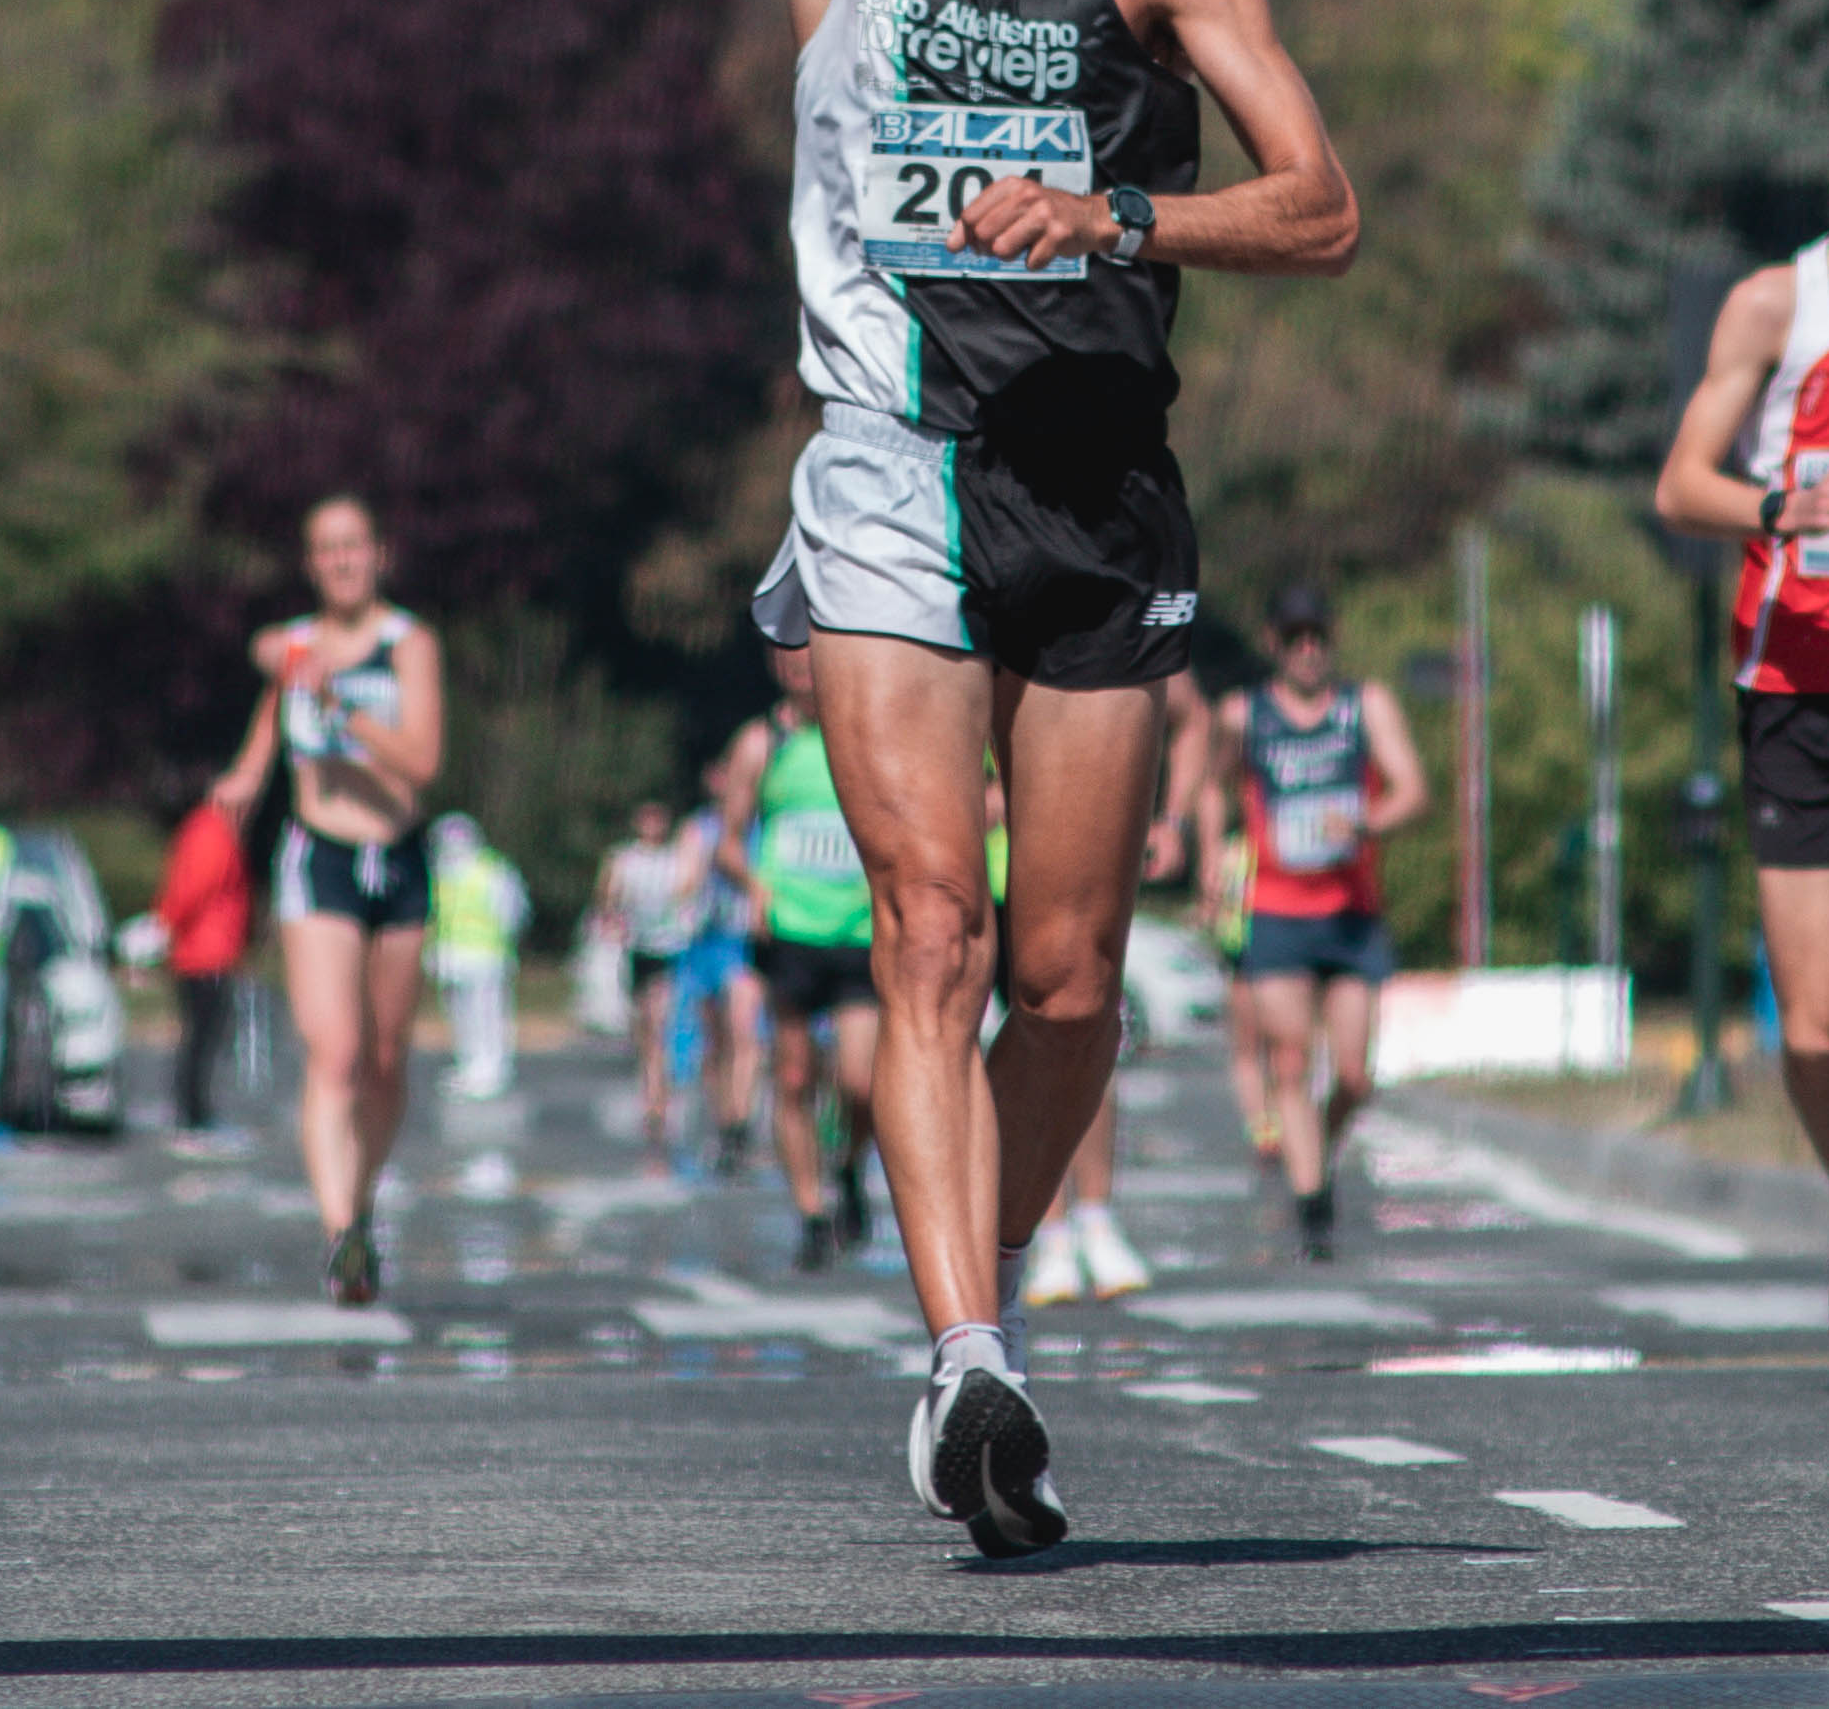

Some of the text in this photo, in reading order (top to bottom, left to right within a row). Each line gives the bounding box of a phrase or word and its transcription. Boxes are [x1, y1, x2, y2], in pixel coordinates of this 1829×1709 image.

[935, 0, 1078, 48] Atletismo
[871, 111, 1082, 151] BALAKI
[872, 143, 1084, 162] SPORTS
[892, 163, 1043, 225] 20
